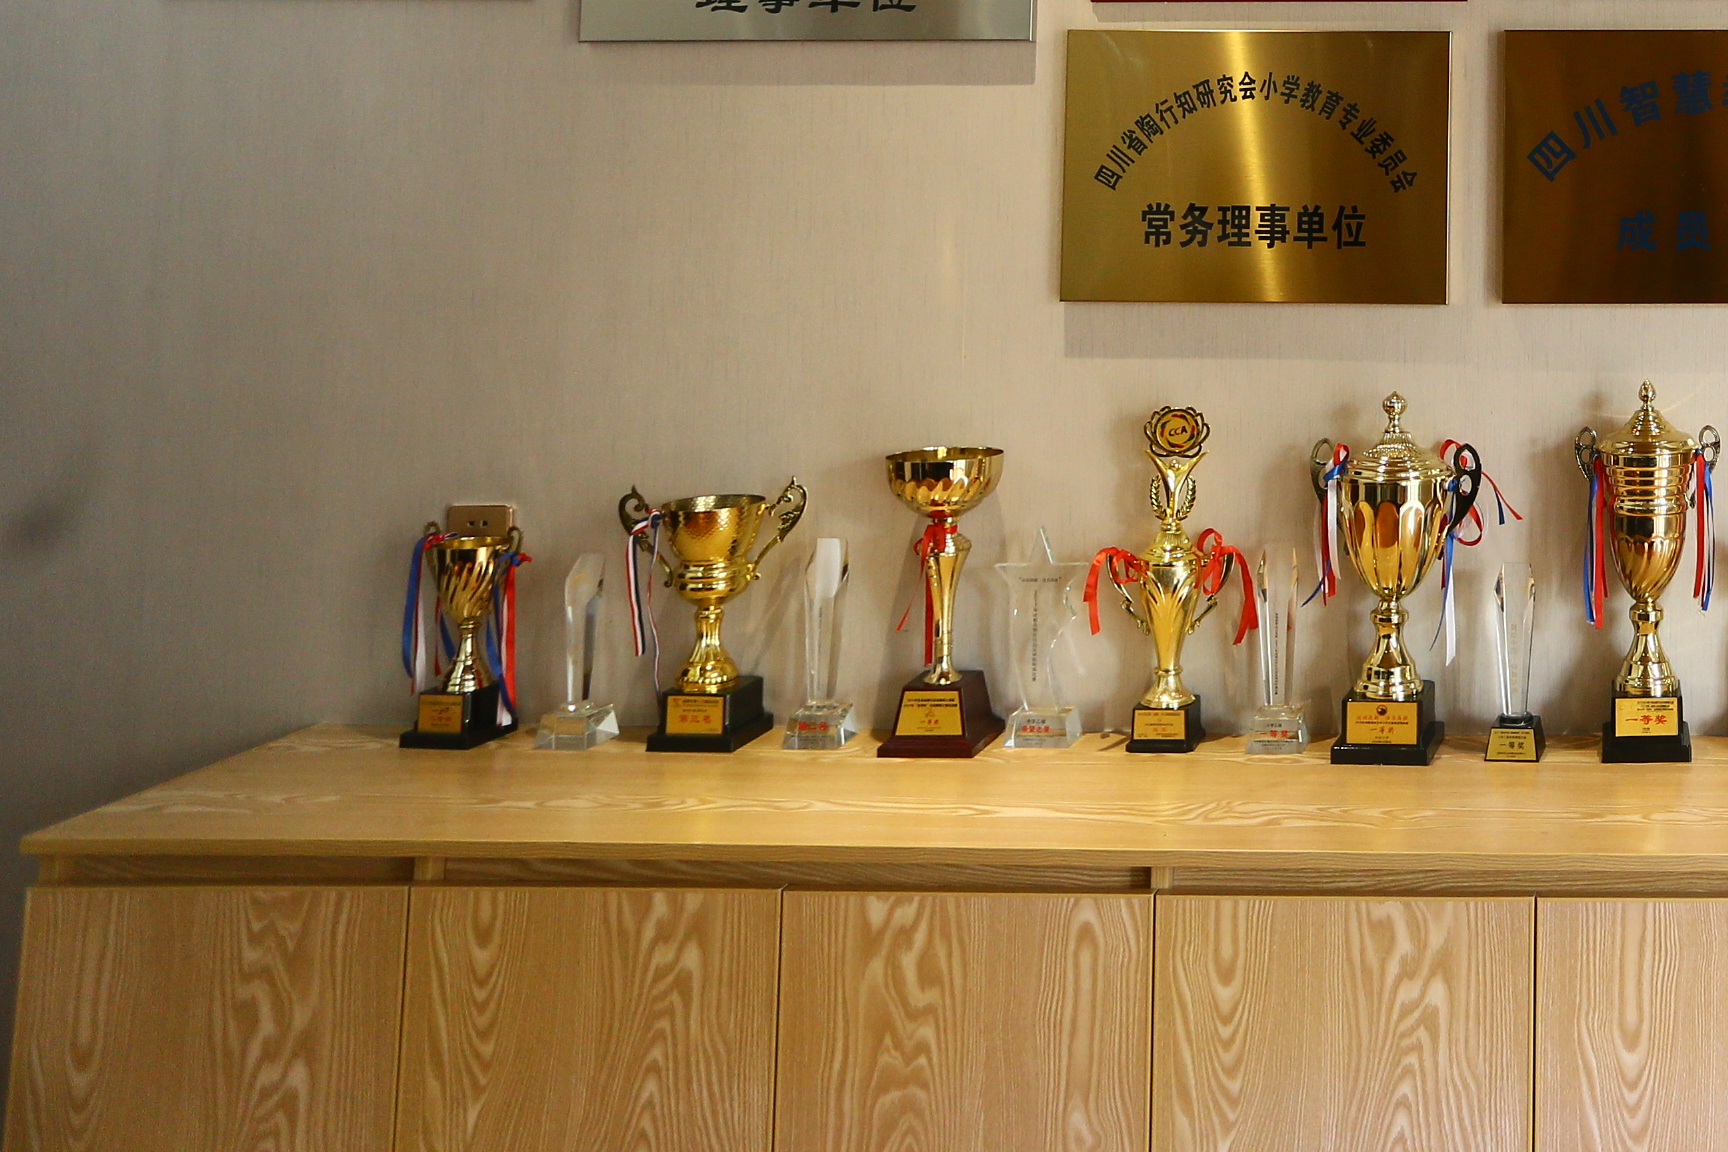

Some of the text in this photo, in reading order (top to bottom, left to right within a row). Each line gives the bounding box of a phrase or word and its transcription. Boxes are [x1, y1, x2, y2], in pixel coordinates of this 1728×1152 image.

[1093, 70, 1419, 195] 四川省陶行知研究会小学教育专业委员会
[1141, 202, 1367, 250] 常务理事单位
[1168, 425, 1188, 437] CCA
[1625, 714, 1668, 726] 一等奖
[1369, 726, 1395, 735] 一等奖
[1499, 741, 1525, 750] 一等奖
